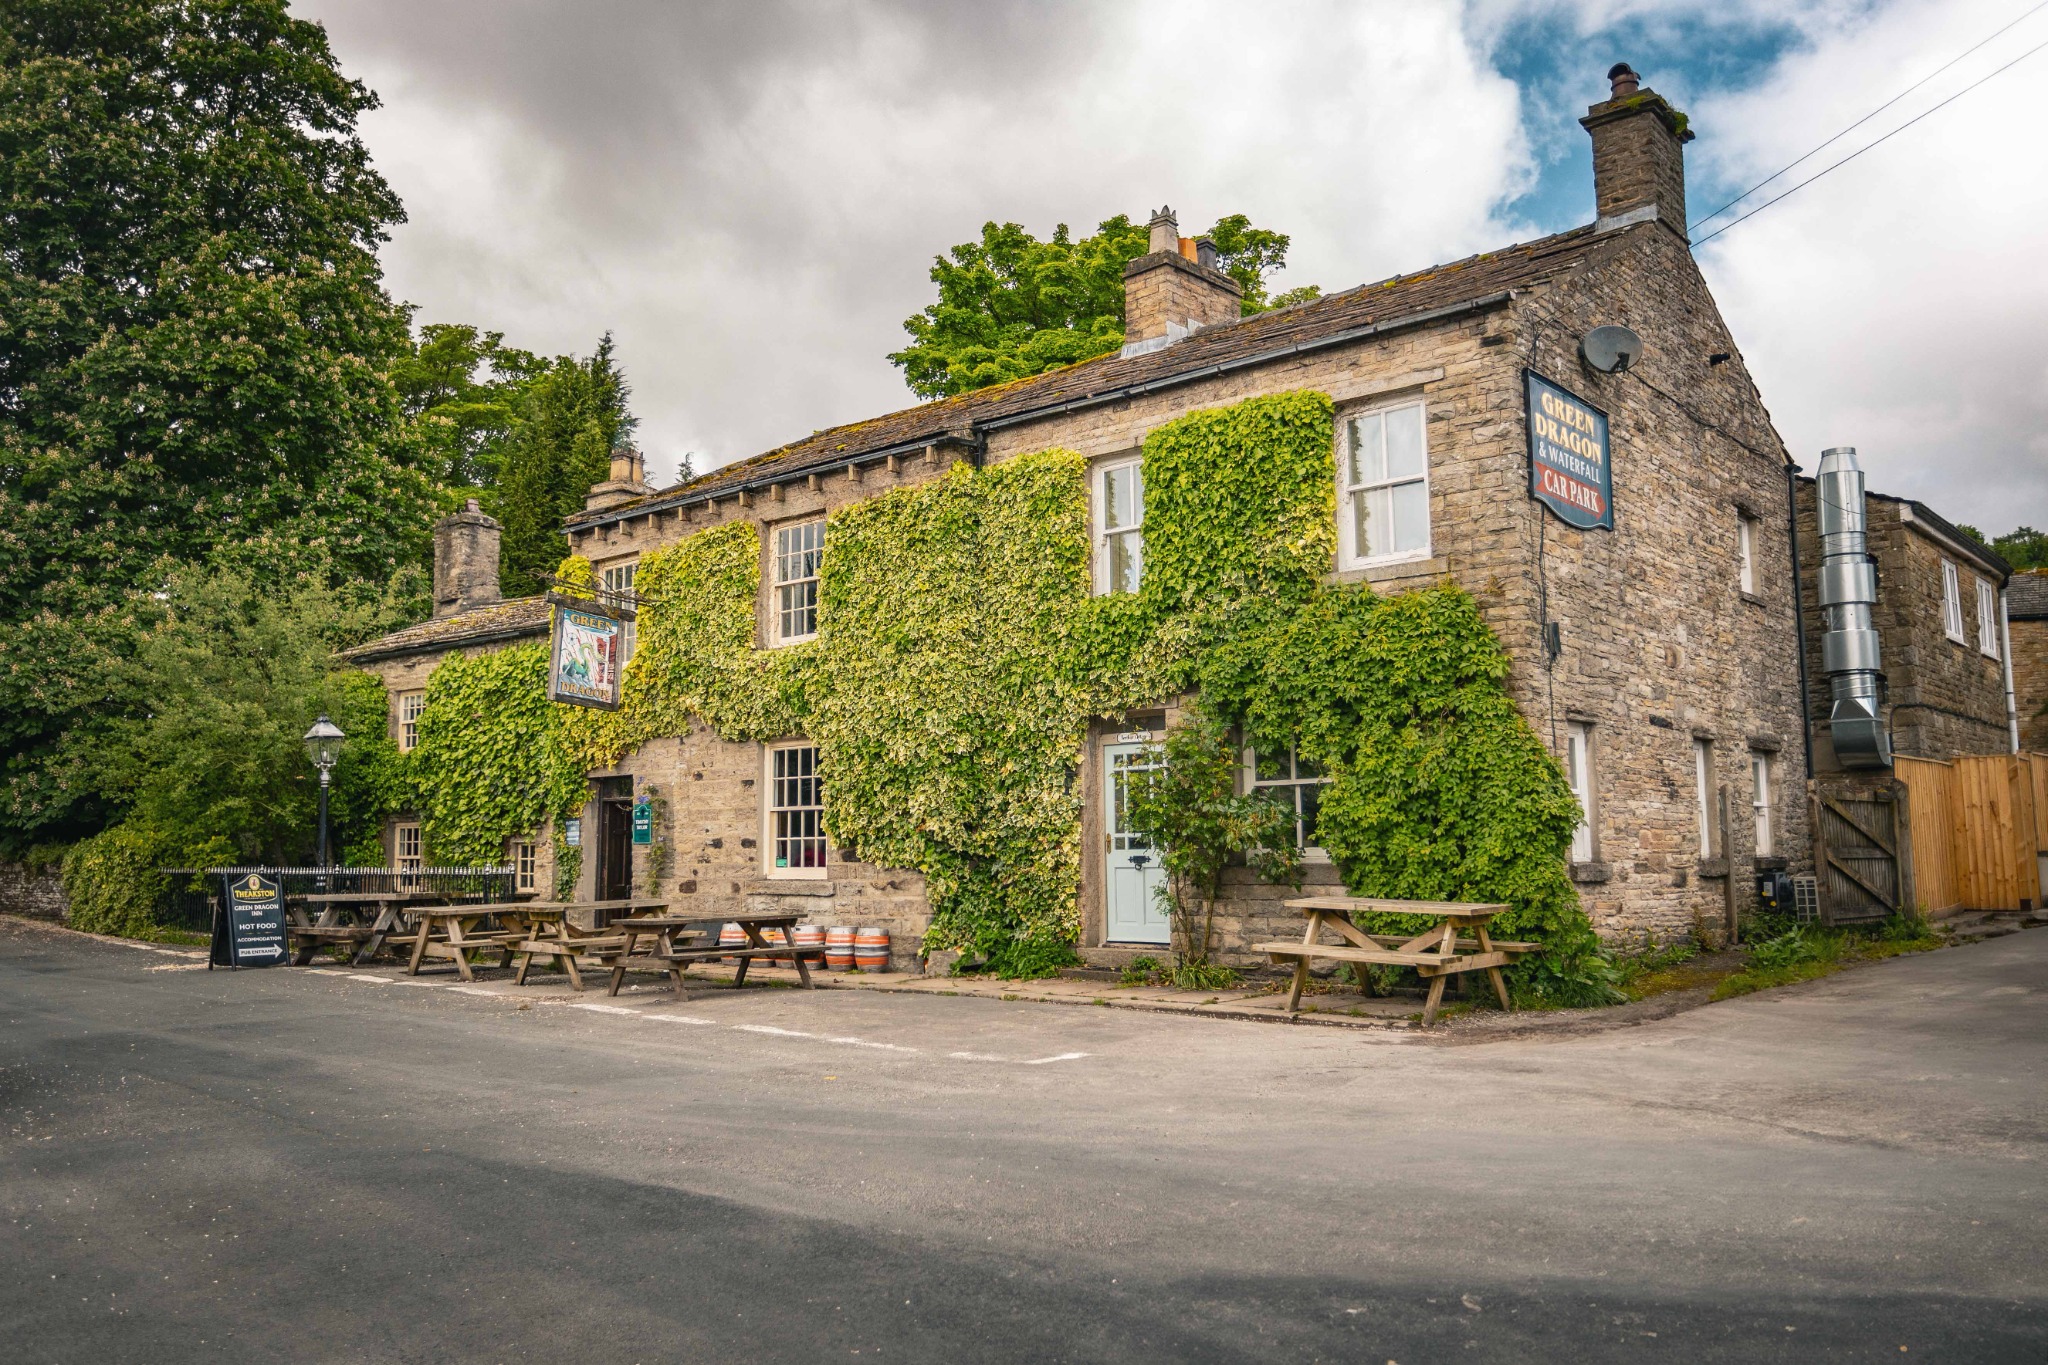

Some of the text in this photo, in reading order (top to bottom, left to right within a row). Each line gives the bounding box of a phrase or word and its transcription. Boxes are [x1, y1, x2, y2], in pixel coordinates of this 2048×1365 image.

[1541, 391, 1595, 436] GREEN
[1535, 412, 1602, 464] DRAGON
[1539, 441, 1601, 484] & WATERFALL
[1544, 469, 1600, 513] CAR PARK
[570, 613, 613, 631] GREEN
[561, 681, 610, 699] DRAGON
[235, 890, 275, 898] THEAKSTON
